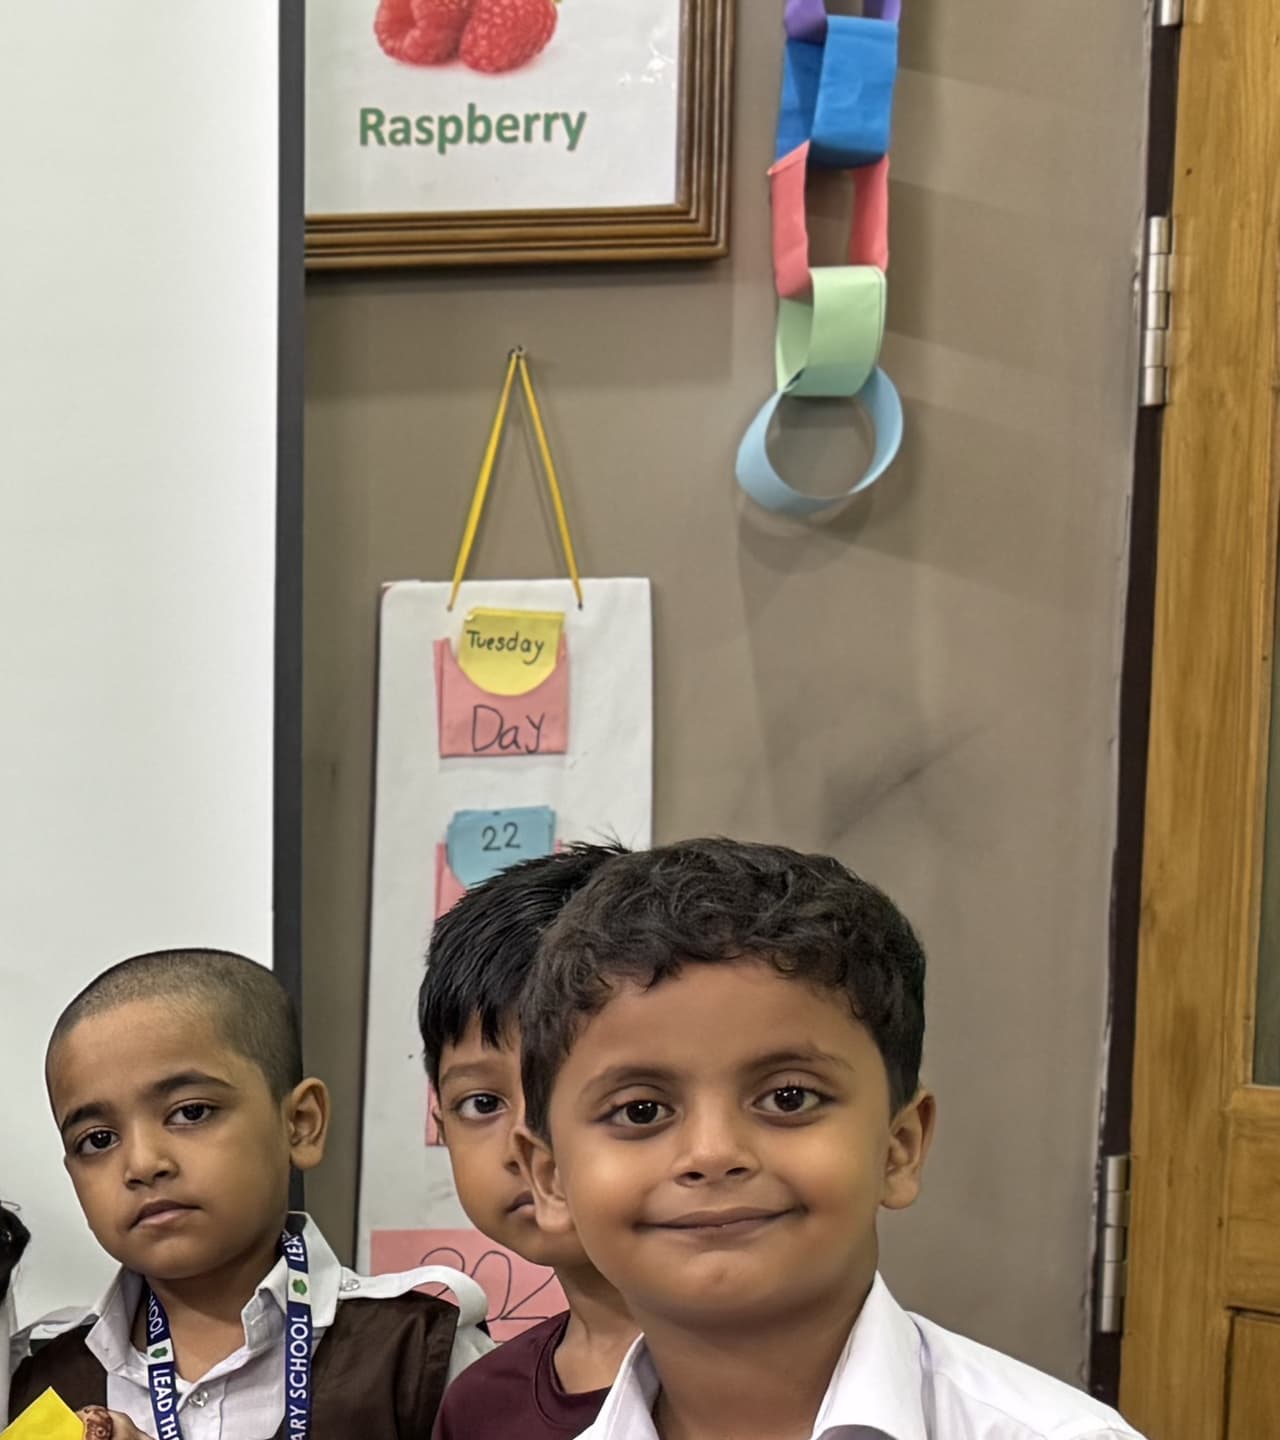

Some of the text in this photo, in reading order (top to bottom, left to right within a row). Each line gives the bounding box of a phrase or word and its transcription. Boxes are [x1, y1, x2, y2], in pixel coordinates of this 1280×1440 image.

[358, 103, 587, 154] Raspberry
[466, 630, 544, 664] Tuesday
[472, 704, 545, 754] Day
[482, 822, 520, 851] 22
[289, 1315, 309, 1399] SCHOOL
[153, 1369, 172, 1413] LEAD
